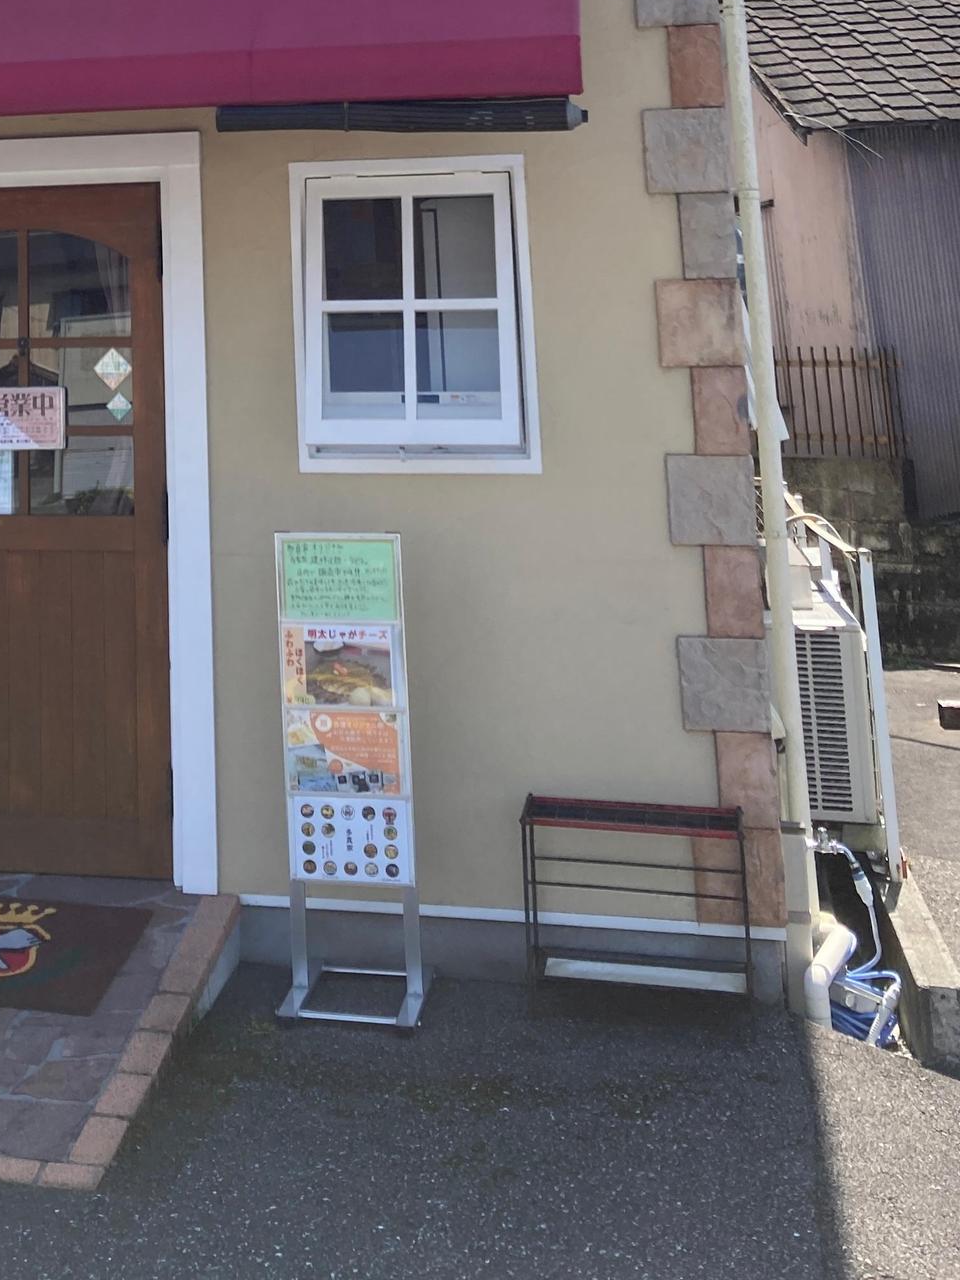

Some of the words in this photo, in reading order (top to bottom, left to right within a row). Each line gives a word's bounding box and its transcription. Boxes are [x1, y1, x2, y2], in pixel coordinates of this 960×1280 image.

[307, 629, 388, 640] 明太じゃがチーズ
